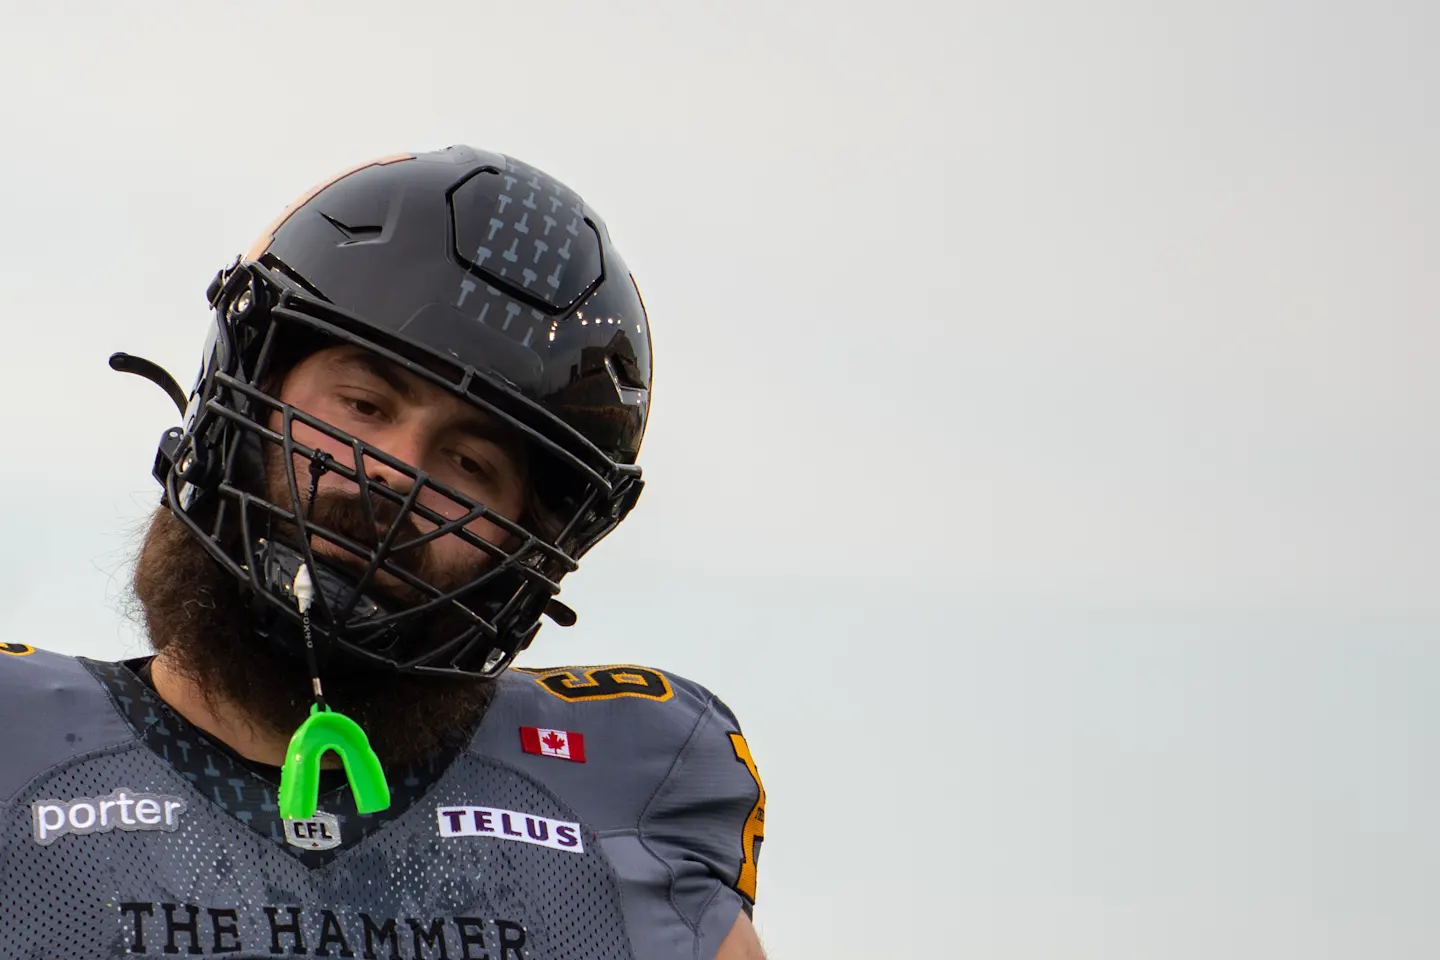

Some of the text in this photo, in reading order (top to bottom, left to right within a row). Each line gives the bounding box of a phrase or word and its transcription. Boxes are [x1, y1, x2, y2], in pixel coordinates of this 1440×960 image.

[38, 792, 181, 840] porter
[293, 821, 333, 839] CFL
[442, 810, 578, 847] TELUS
[120, 902, 242, 955] THE
